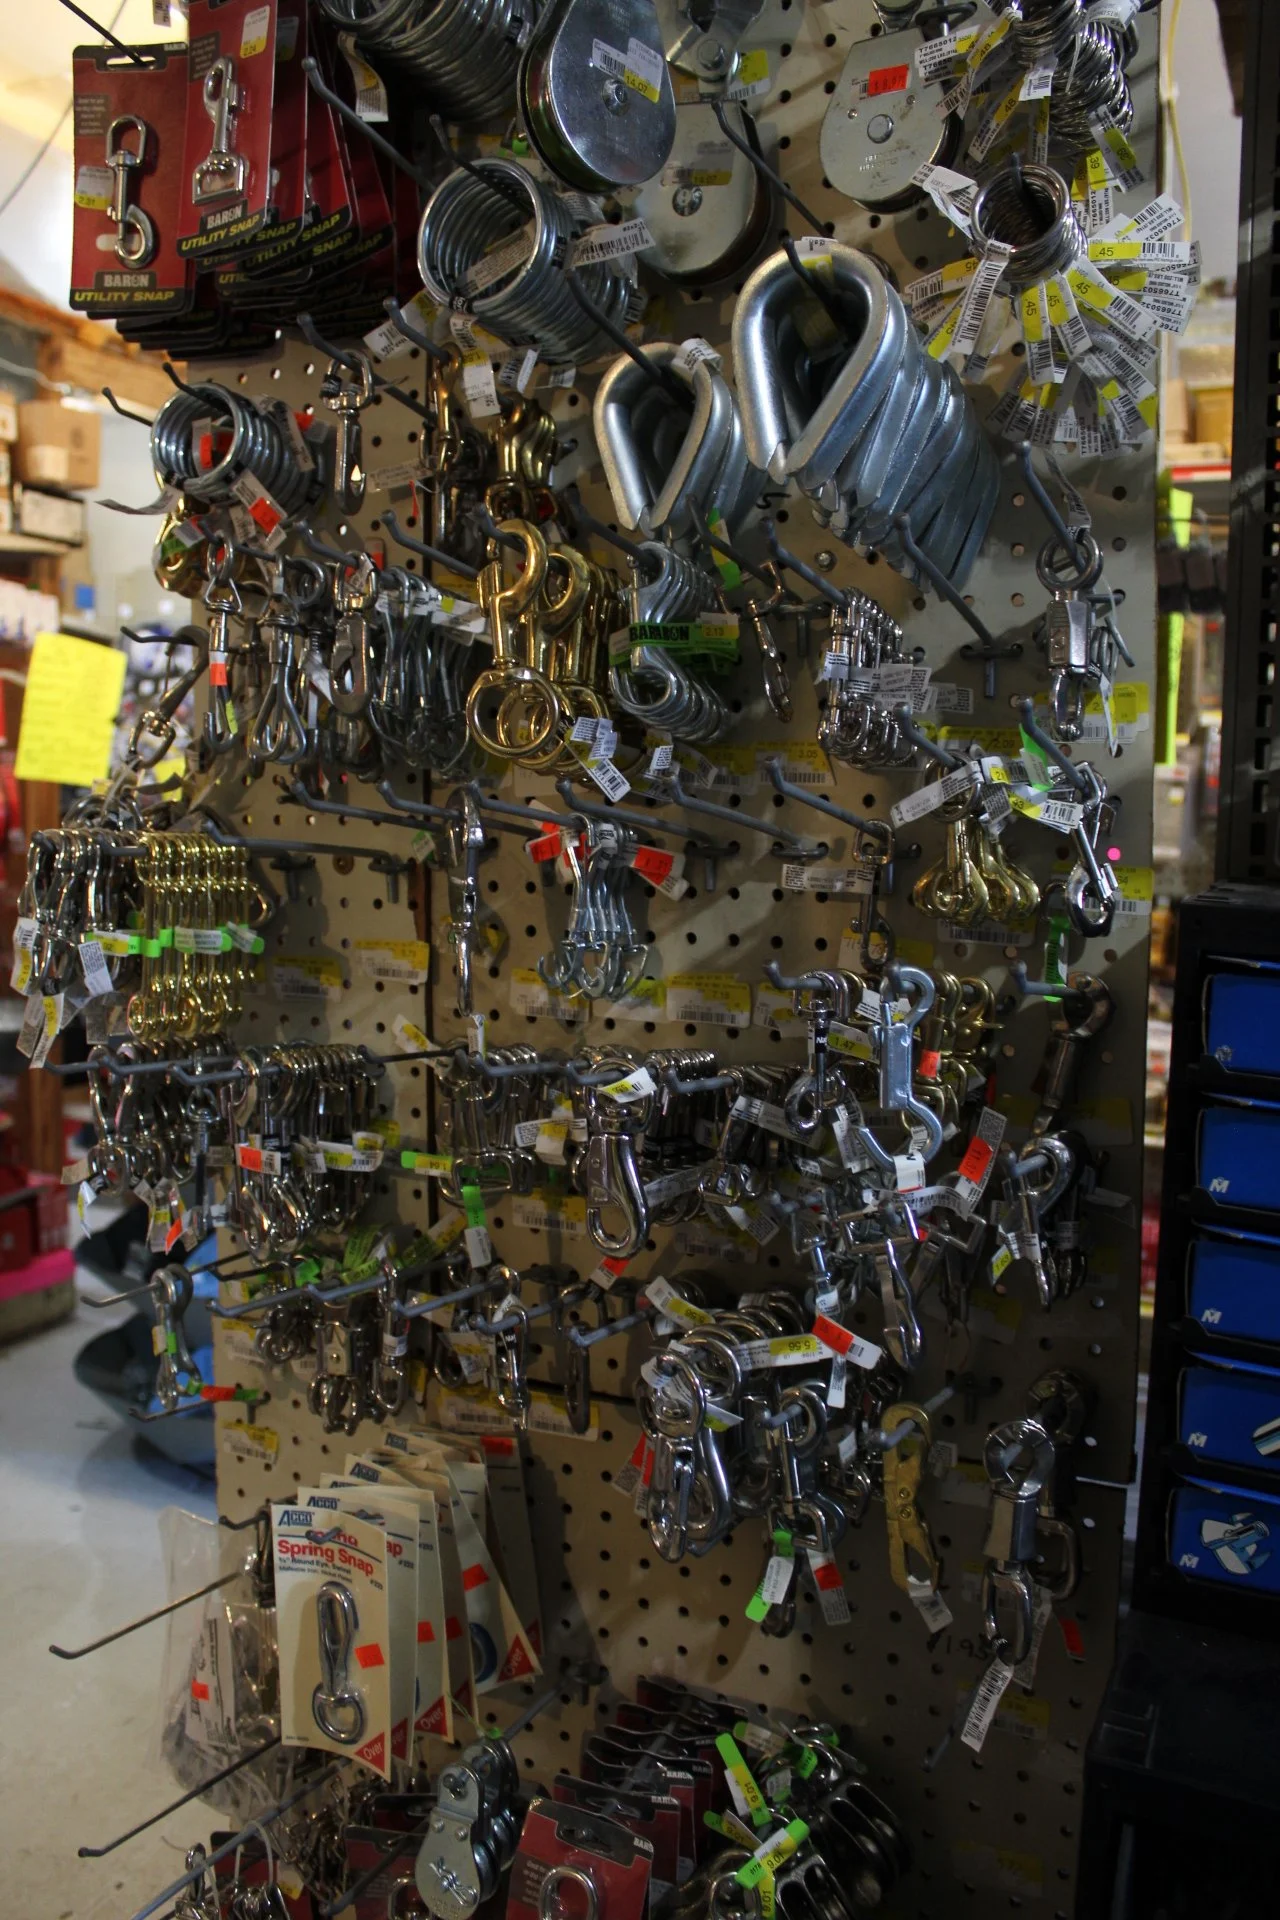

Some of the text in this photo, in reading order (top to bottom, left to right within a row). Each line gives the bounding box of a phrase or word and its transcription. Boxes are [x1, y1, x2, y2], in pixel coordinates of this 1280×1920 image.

[919, 36, 957, 53] T7665012
[626, 75, 648, 93] 14.07
[207, 205, 243, 230] BARON
[181, 231, 226, 251] UTILITY
[229, 214, 260, 236] SNAP
[256, 221, 297, 242] SNAP
[302, 213, 342, 242] SNAP
[312, 232, 353, 257] SNAP
[1095, 246, 1114, 258] .45
[103, 274, 149, 288] BARON
[1071, 281, 1090, 295] .45
[74, 291, 175, 302] UTILITY SNAP
[1047, 294, 1060, 308] .45
[1024, 298, 1037, 317] .45
[799, 749, 818, 759] 3.05
[834, 1036, 855, 1051] 1.47
[788, 1340, 812, 1352] 5.56
[350, 1462, 381, 1482] ACCO
[307, 1496, 338, 1510] ACCO
[278, 1510, 313, 1527] ACCO
[278, 1539, 374, 1577] Spring Snap
[504, 1646, 525, 1678] Over
[420, 1707, 445, 1731] Over
[362, 1741, 384, 1761] Over
[744, 1782, 760, 1804] 9.01
[766, 1850, 787, 1870] 9.01
[763, 1889, 773, 1914] 9.01
